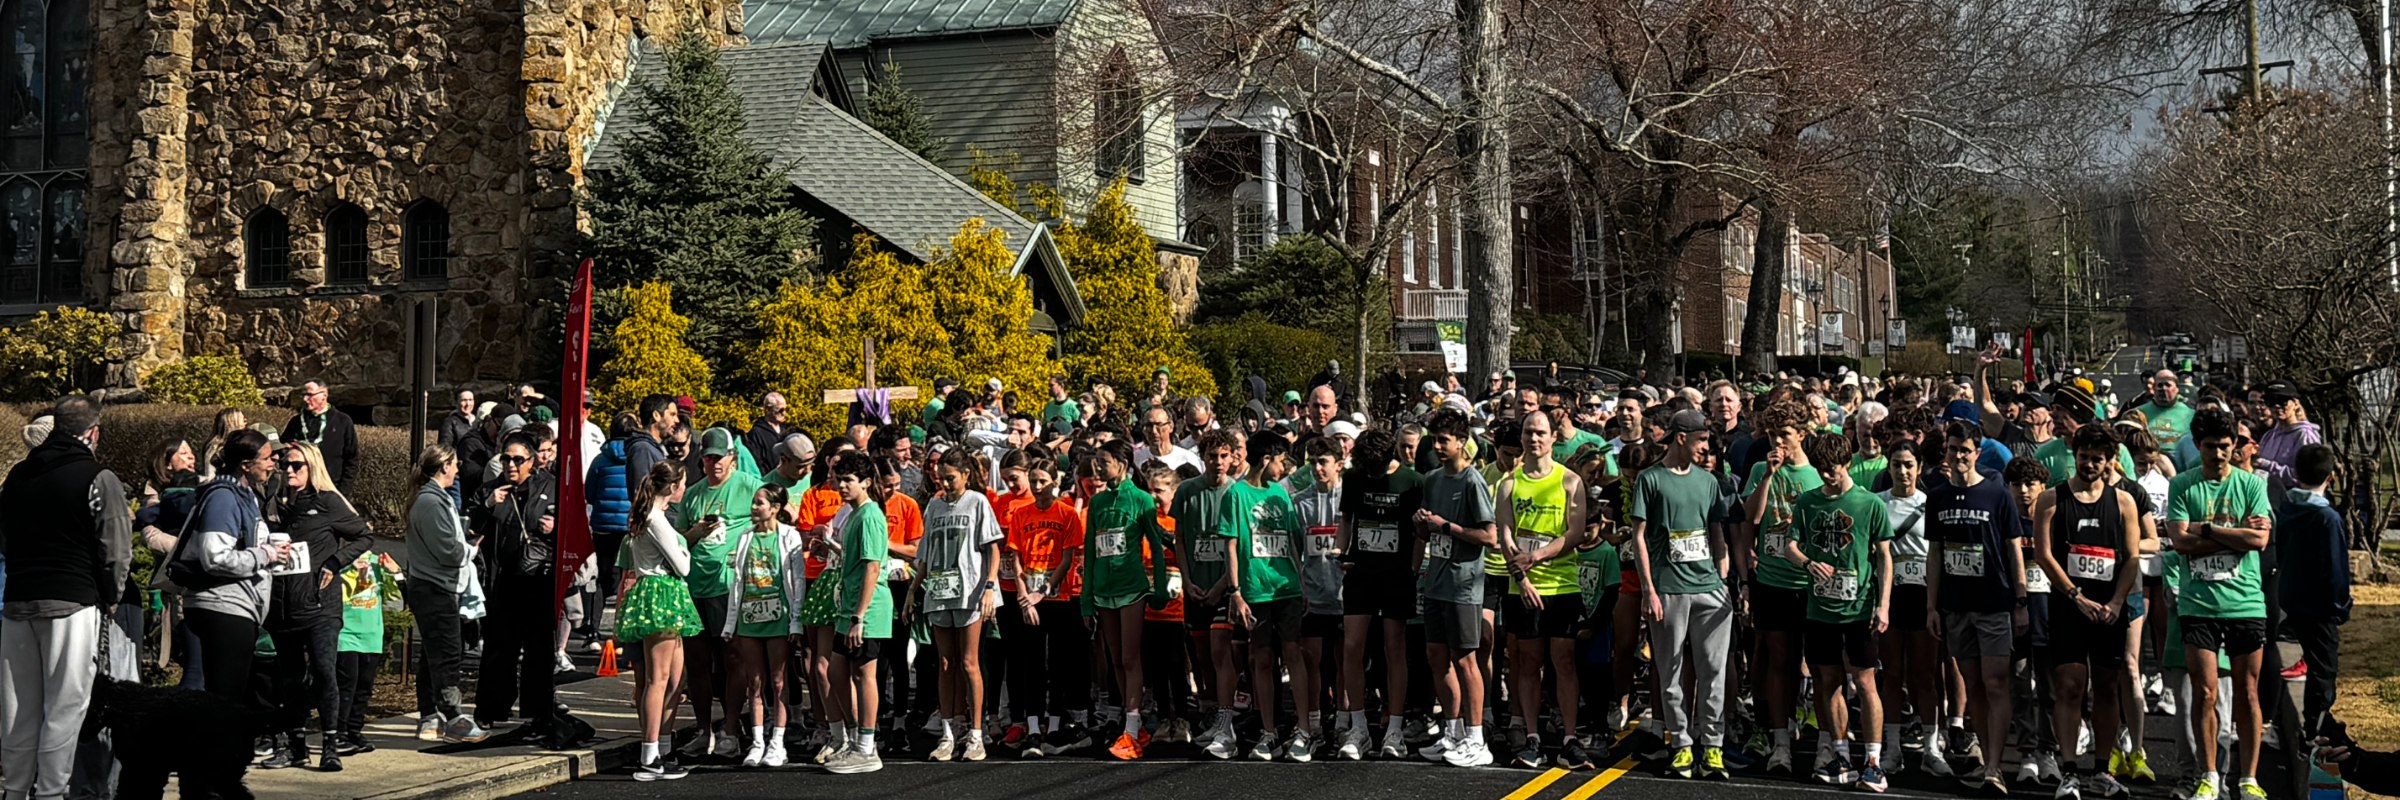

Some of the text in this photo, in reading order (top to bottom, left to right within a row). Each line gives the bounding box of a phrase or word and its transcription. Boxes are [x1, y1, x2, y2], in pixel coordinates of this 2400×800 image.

[1370, 530, 1383, 543] 77
[1199, 541, 1218, 554] 221
[1952, 552, 1970, 567] 176
[2078, 556, 2104, 575] 958
[2203, 557, 2225, 571] 145
[1904, 562, 1918, 576] 65
[751, 601, 769, 614] 231
